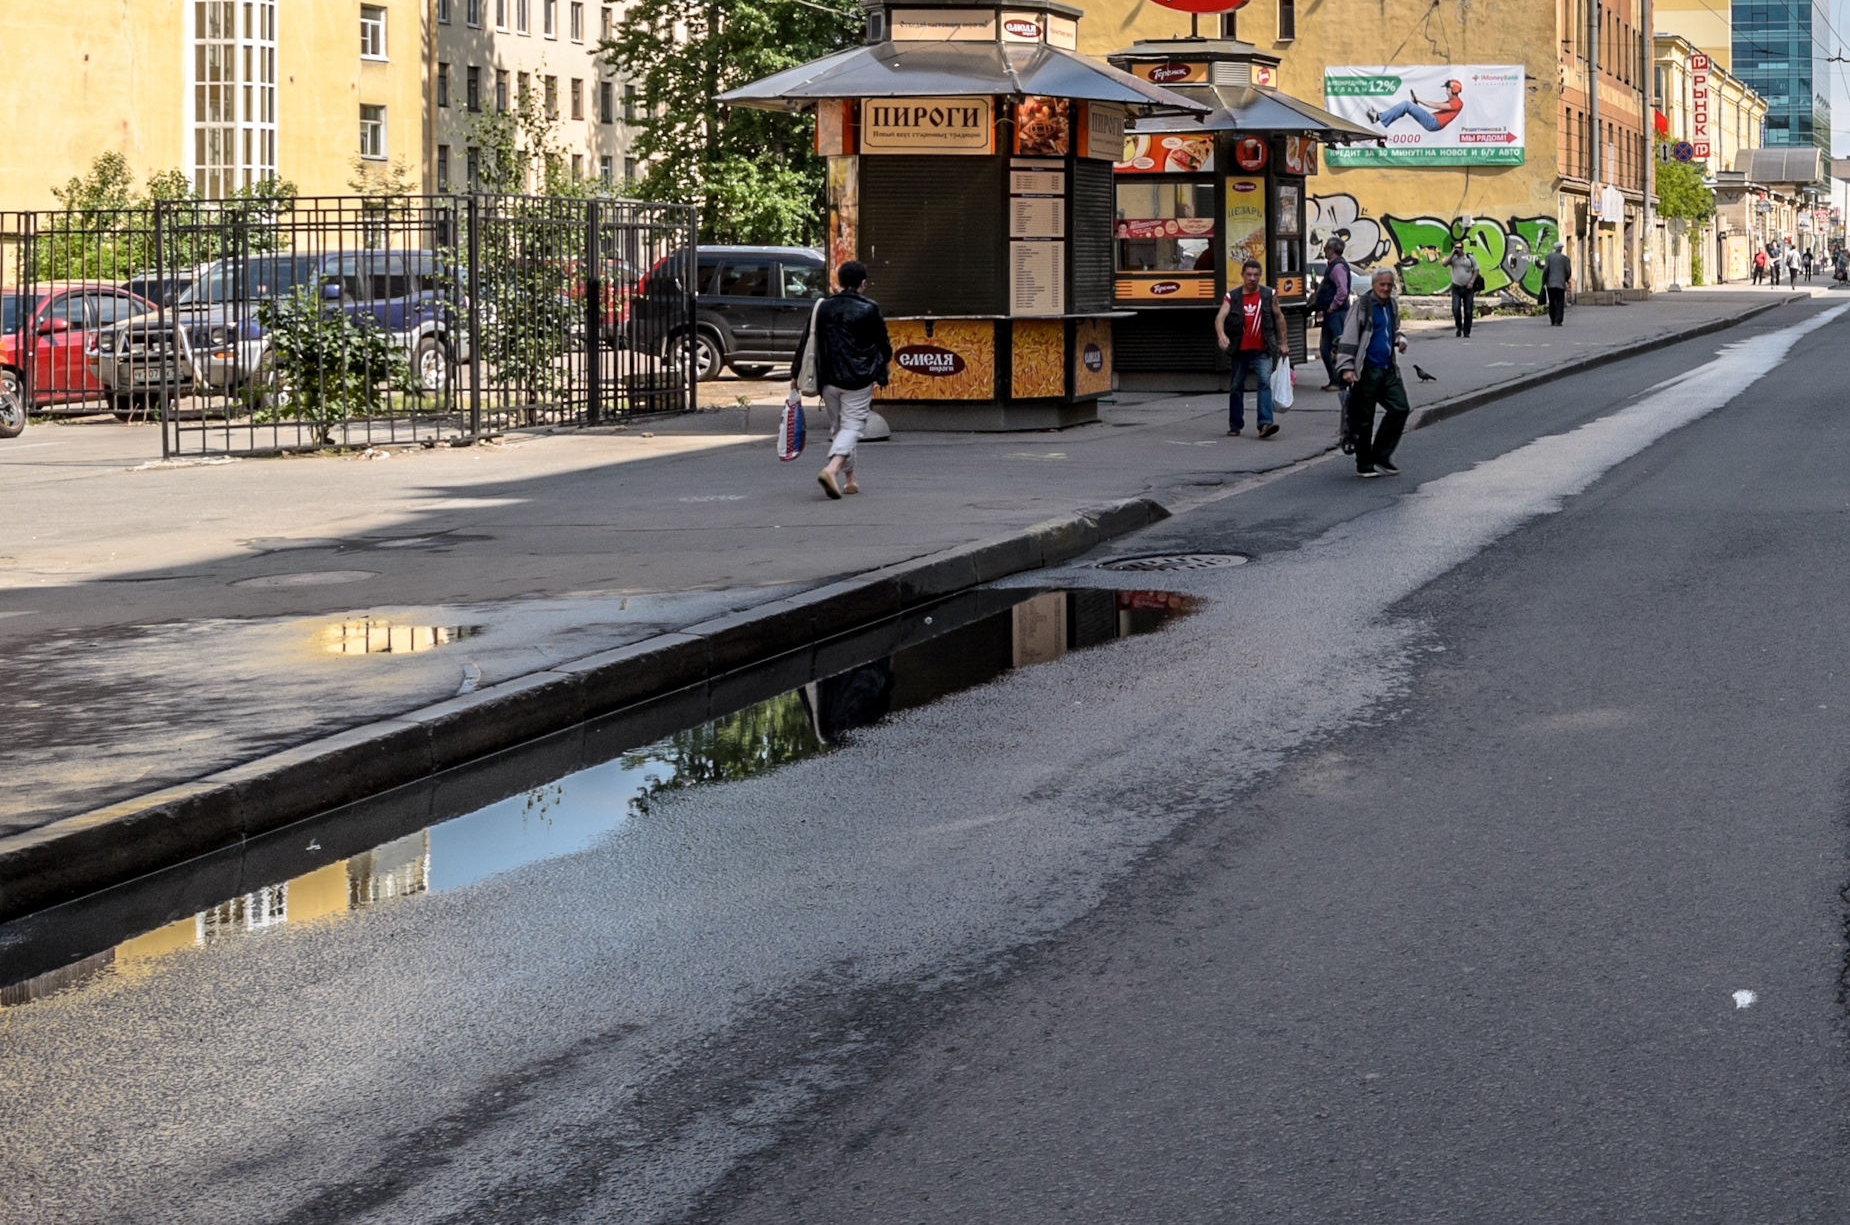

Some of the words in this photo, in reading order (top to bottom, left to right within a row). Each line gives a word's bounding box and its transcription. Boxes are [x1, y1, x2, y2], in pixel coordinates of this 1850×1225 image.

[1694, 75, 1707, 136] РЫНОК
[872, 107, 980, 127] ПИРОГИ
[1330, 150, 1361, 158] КРЕДИТ
[1481, 148, 1495, 156] Б/У
[1499, 148, 1520, 156] АВТО
